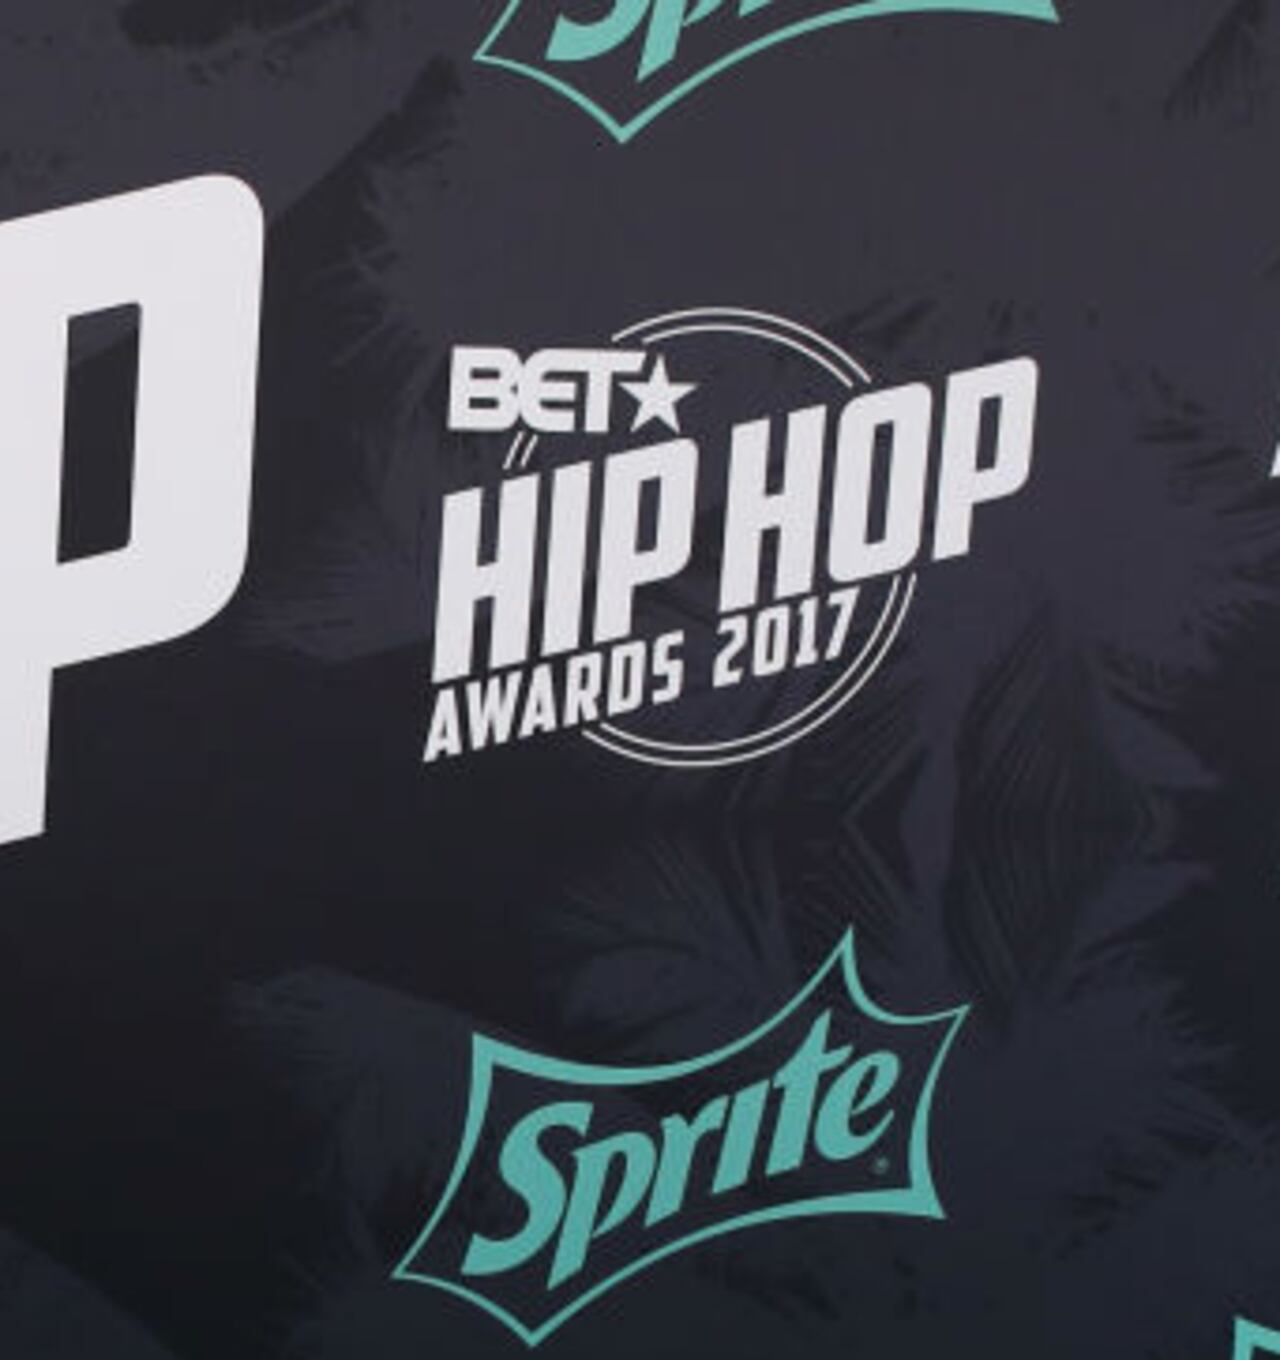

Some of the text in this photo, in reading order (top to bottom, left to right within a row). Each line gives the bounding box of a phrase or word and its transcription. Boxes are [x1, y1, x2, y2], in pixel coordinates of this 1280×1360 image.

[446, 344, 647, 434] BET
[432, 356, 1039, 684] HIP HOP
[422, 586, 861, 764] AWARDS 2017
[460, 1008, 900, 1292] Sprite
